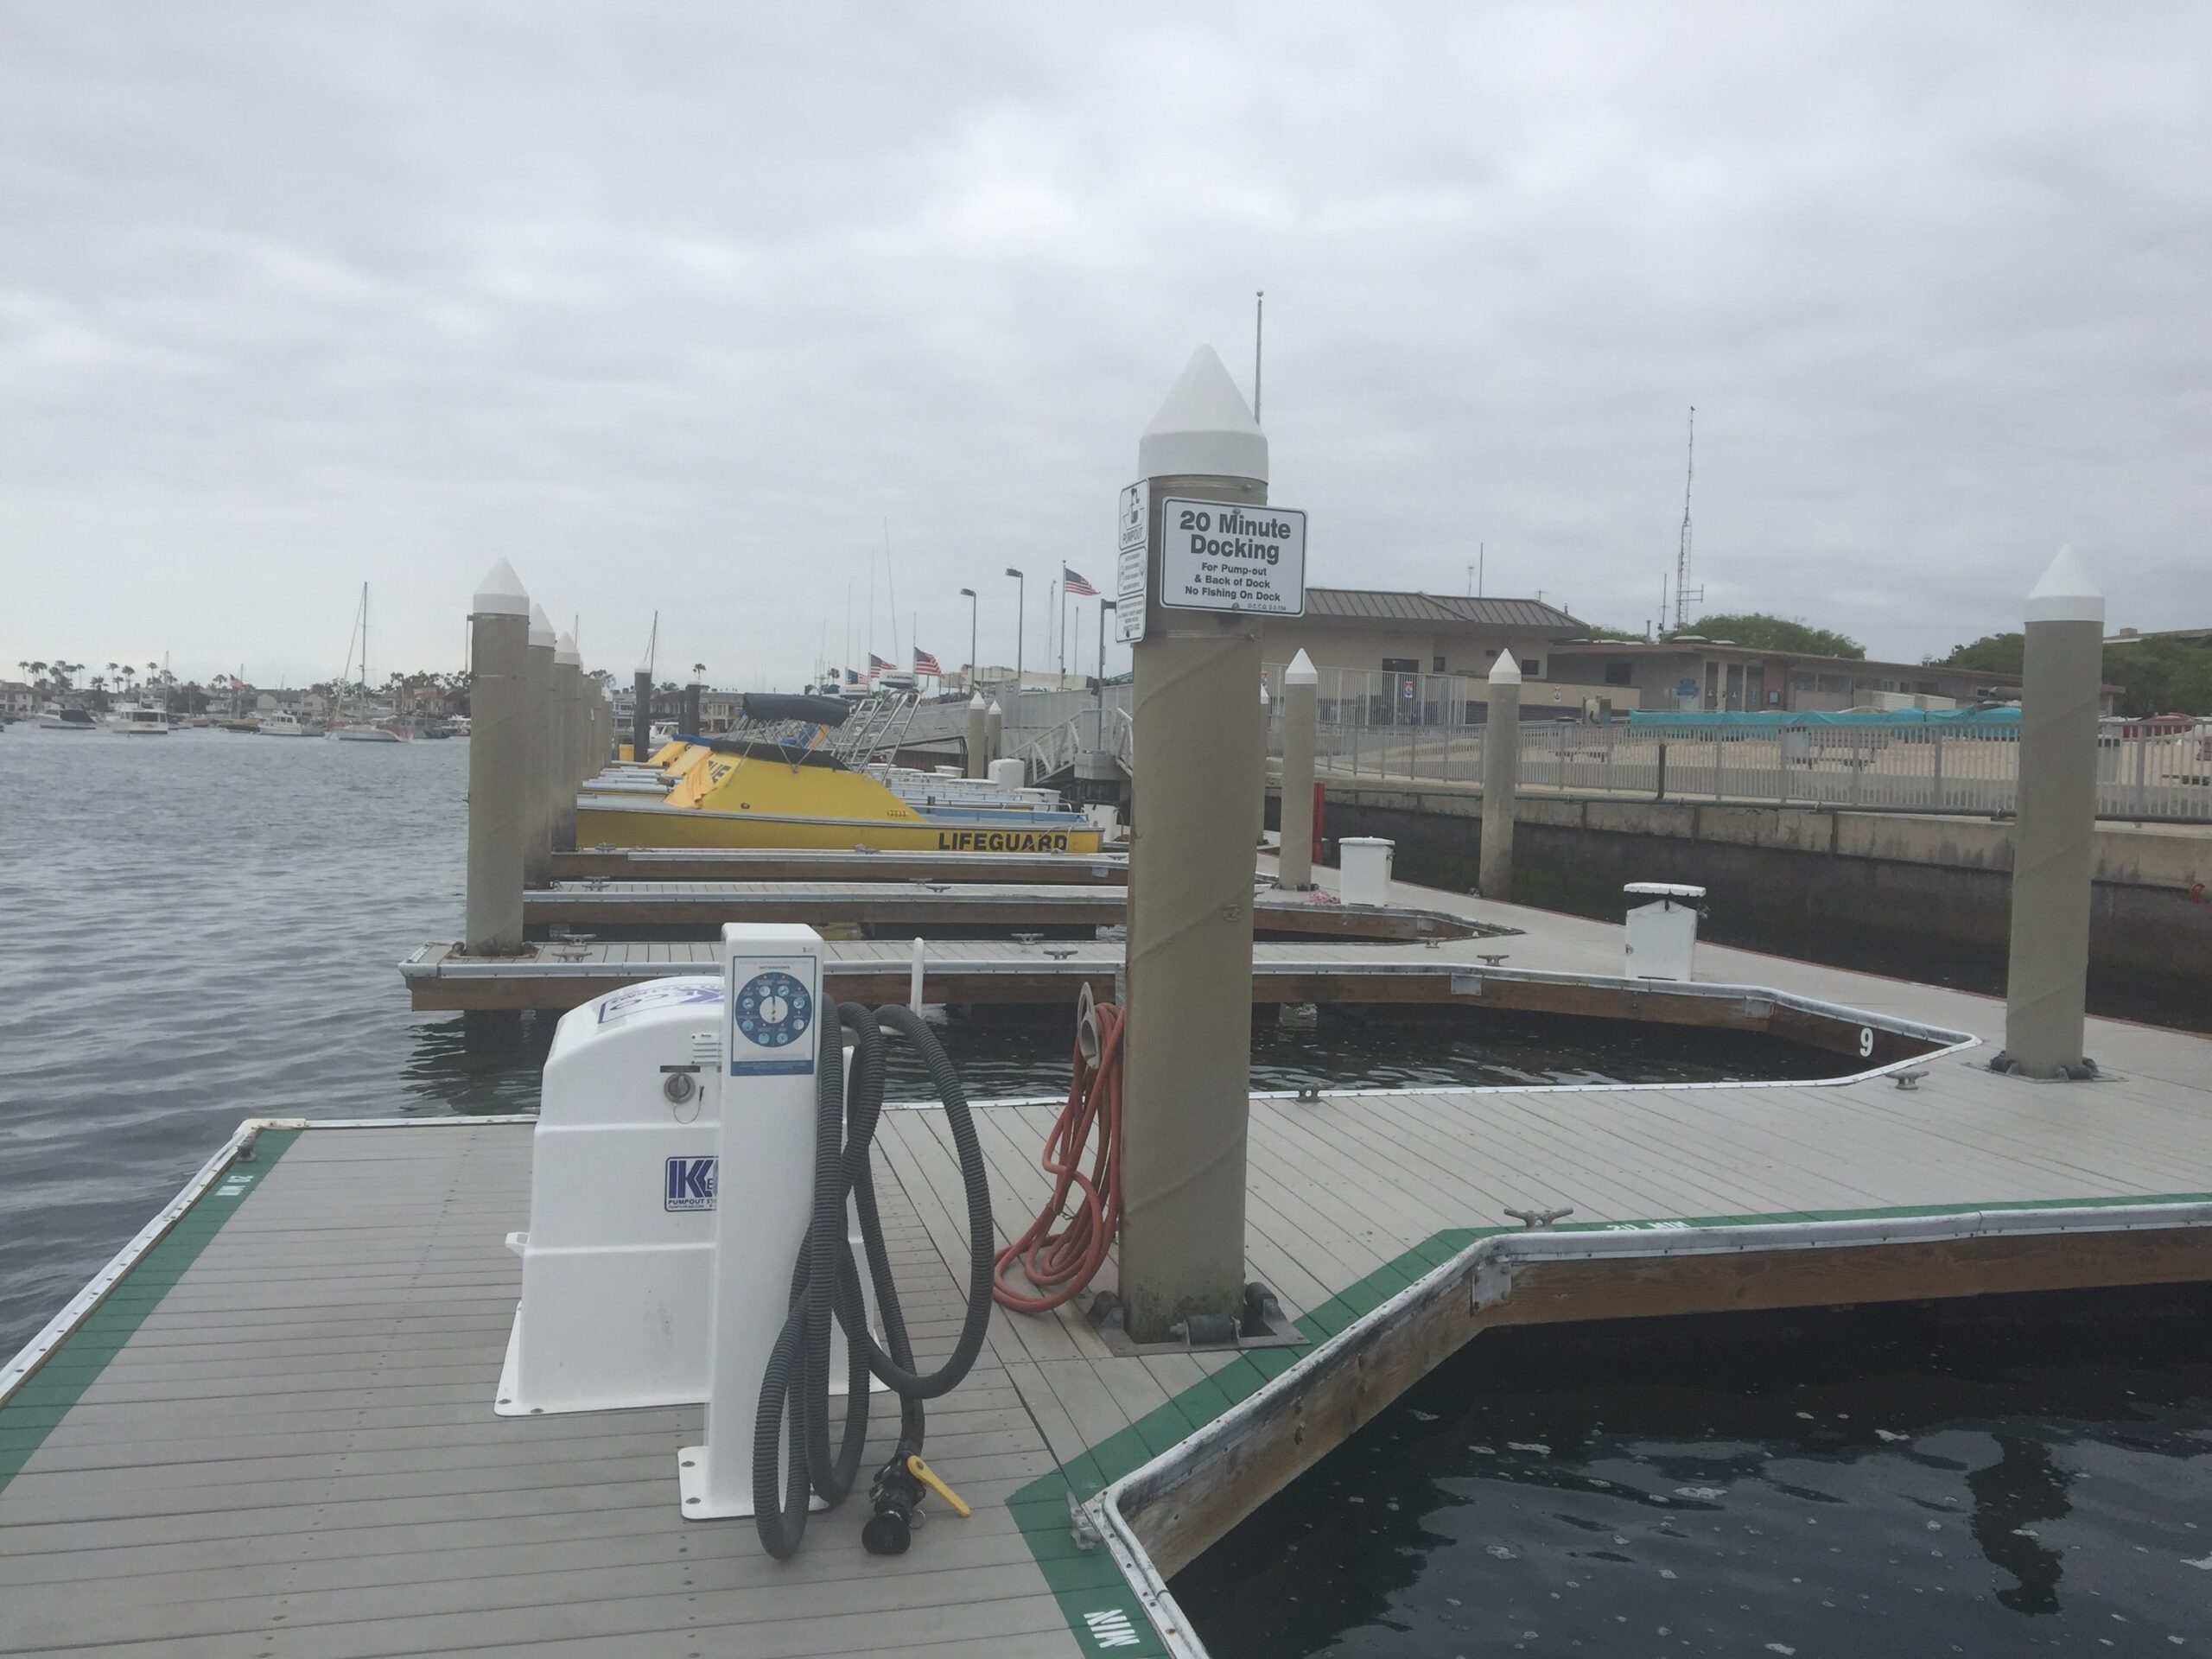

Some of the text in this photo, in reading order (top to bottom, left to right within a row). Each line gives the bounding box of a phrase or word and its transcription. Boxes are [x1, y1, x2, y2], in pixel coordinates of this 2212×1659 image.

[1179, 511, 1292, 539] 20 Minute
[1191, 534, 1280, 565] Docking
[1202, 563, 1267, 576] For Pump-out
[1194, 575, 1270, 588] & Back of Dock
[1185, 586, 1281, 602] No Fishing On Dock
[938, 832, 1067, 852] LIFEGUARD
[1859, 1027, 1873, 1057] 9
